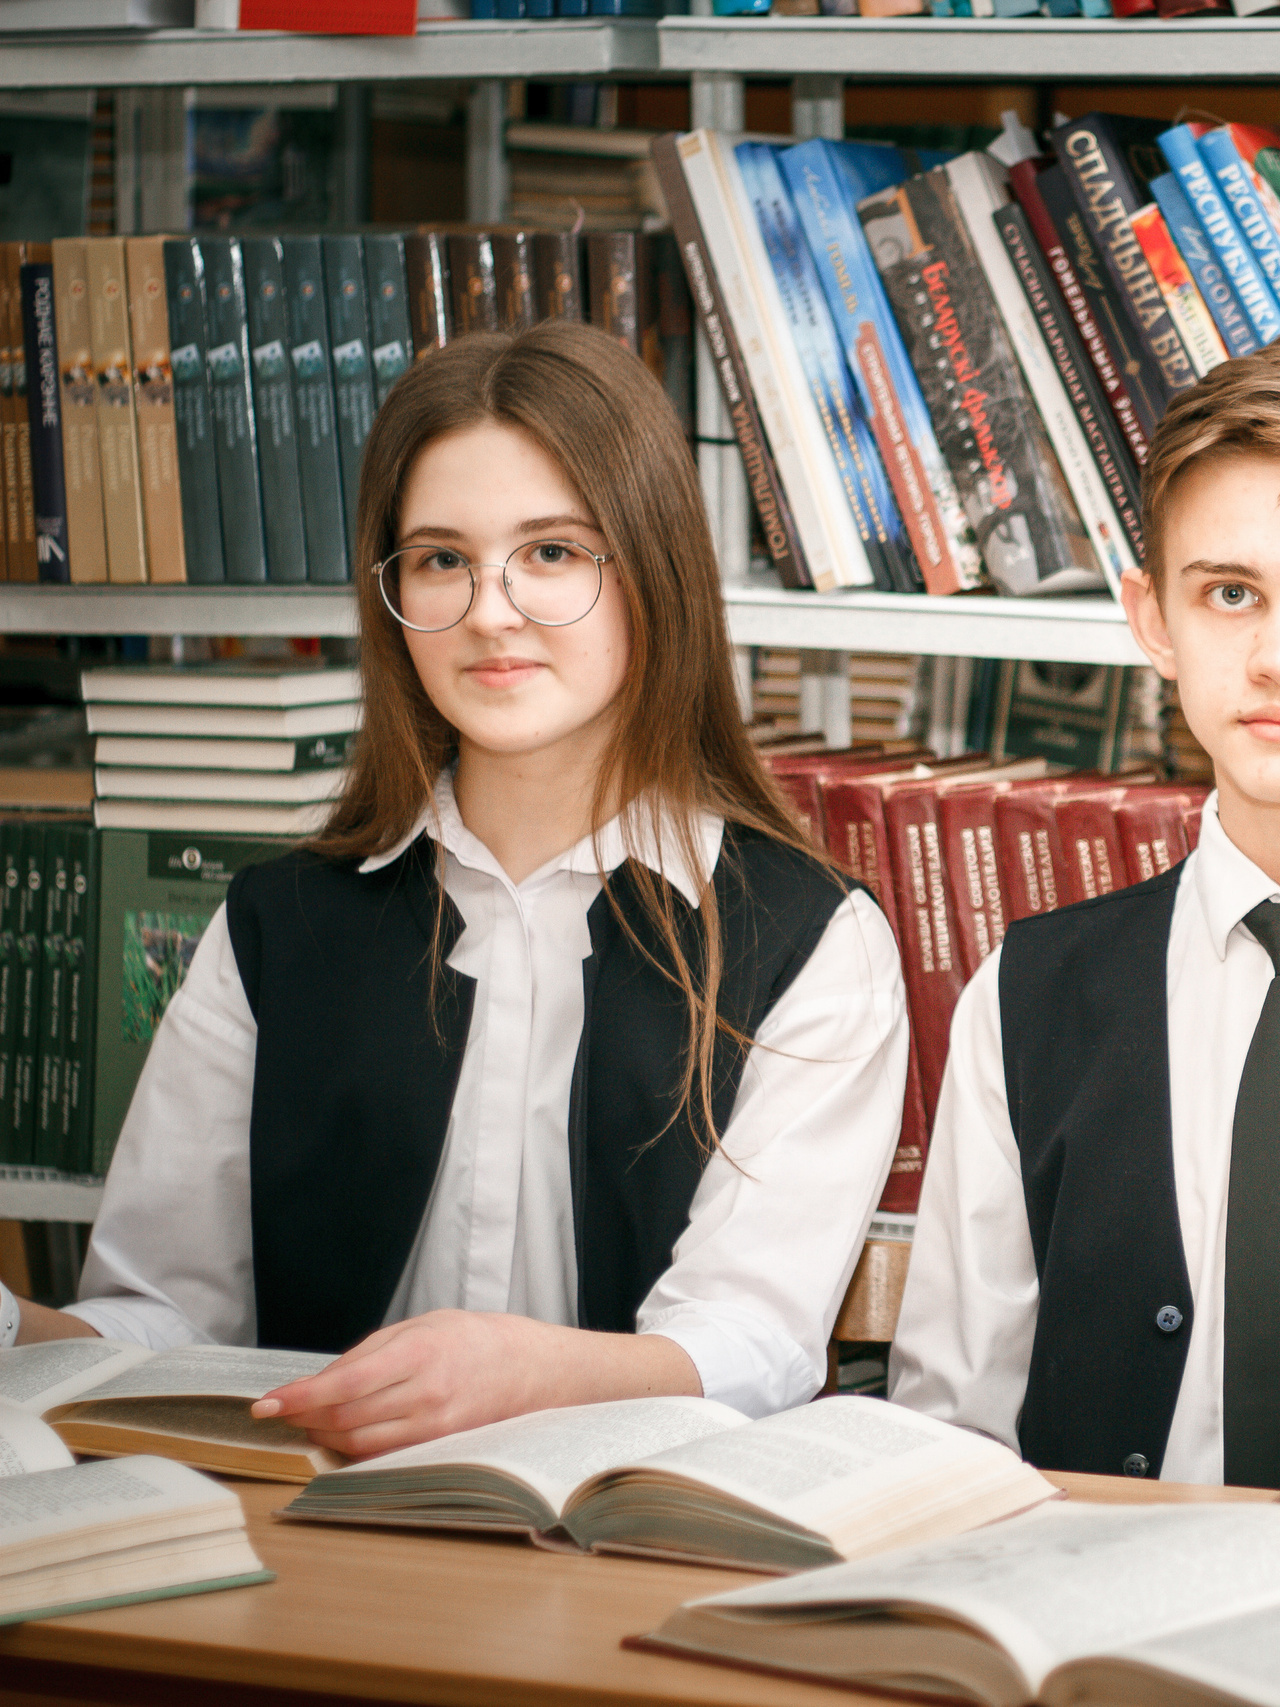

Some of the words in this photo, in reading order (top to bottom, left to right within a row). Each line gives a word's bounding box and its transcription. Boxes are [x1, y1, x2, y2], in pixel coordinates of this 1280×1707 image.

[1060, 124, 1170, 331] СПАДЧЫНА
[1000, 220, 1051, 314] СУЧАСНАЕ
[1037, 311, 1088, 406] НАРОДНАЕ
[1075, 404, 1130, 510] МАСТАЦТВА
[1045, 243, 1122, 396] ГОМЕЛЬШЧЫНА
[727, 401, 791, 560] ГОМЕЛЬЩИНА
[904, 822, 928, 904] СОВЕТСКАЯ
[921, 820, 953, 971] ЭНЦИКЛОПЕДИЯ
[959, 825, 985, 909] СОВЕТСКАЯ
[1016, 830, 1043, 912] СОВЕТСКАЯ
